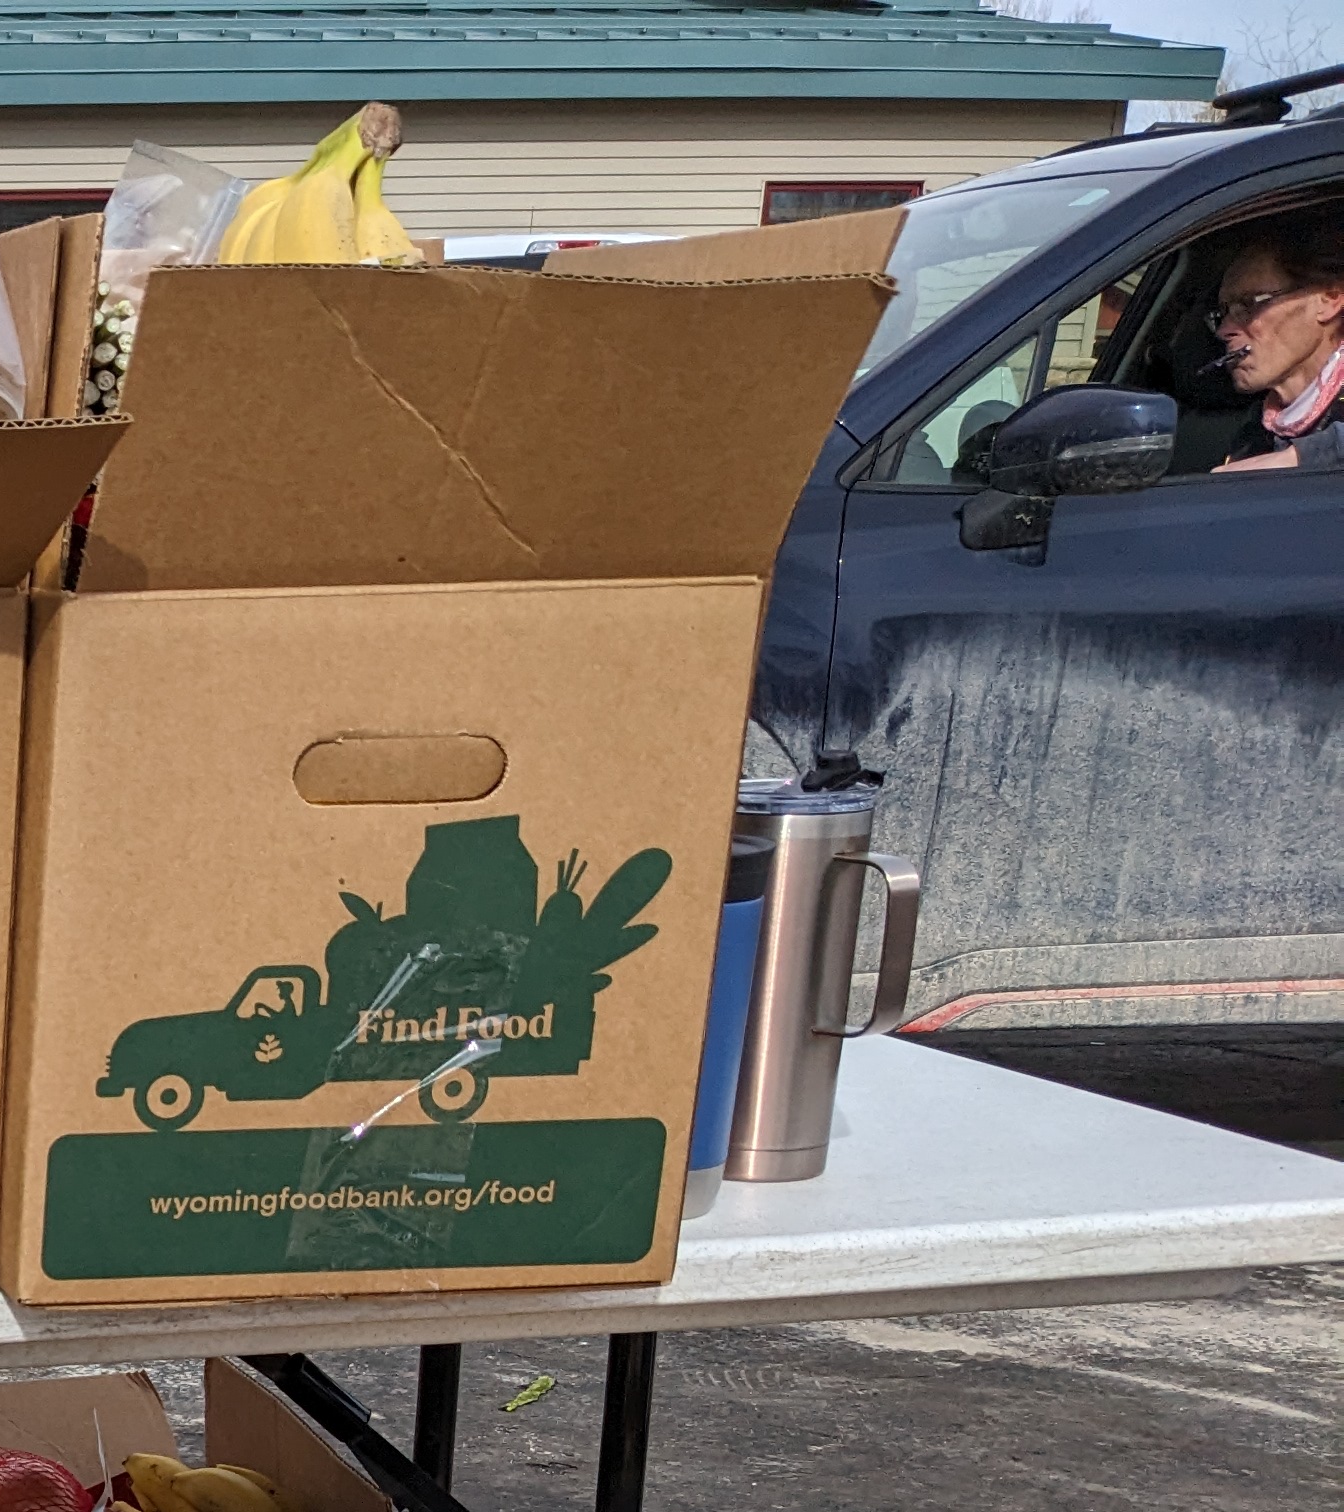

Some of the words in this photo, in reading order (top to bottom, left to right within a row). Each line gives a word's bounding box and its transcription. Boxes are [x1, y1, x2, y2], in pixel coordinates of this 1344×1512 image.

[355, 1007, 445, 1045] Find
[455, 1003, 553, 1041] Food
[150, 1179, 555, 1220] wyomingfoodbank.org/food
